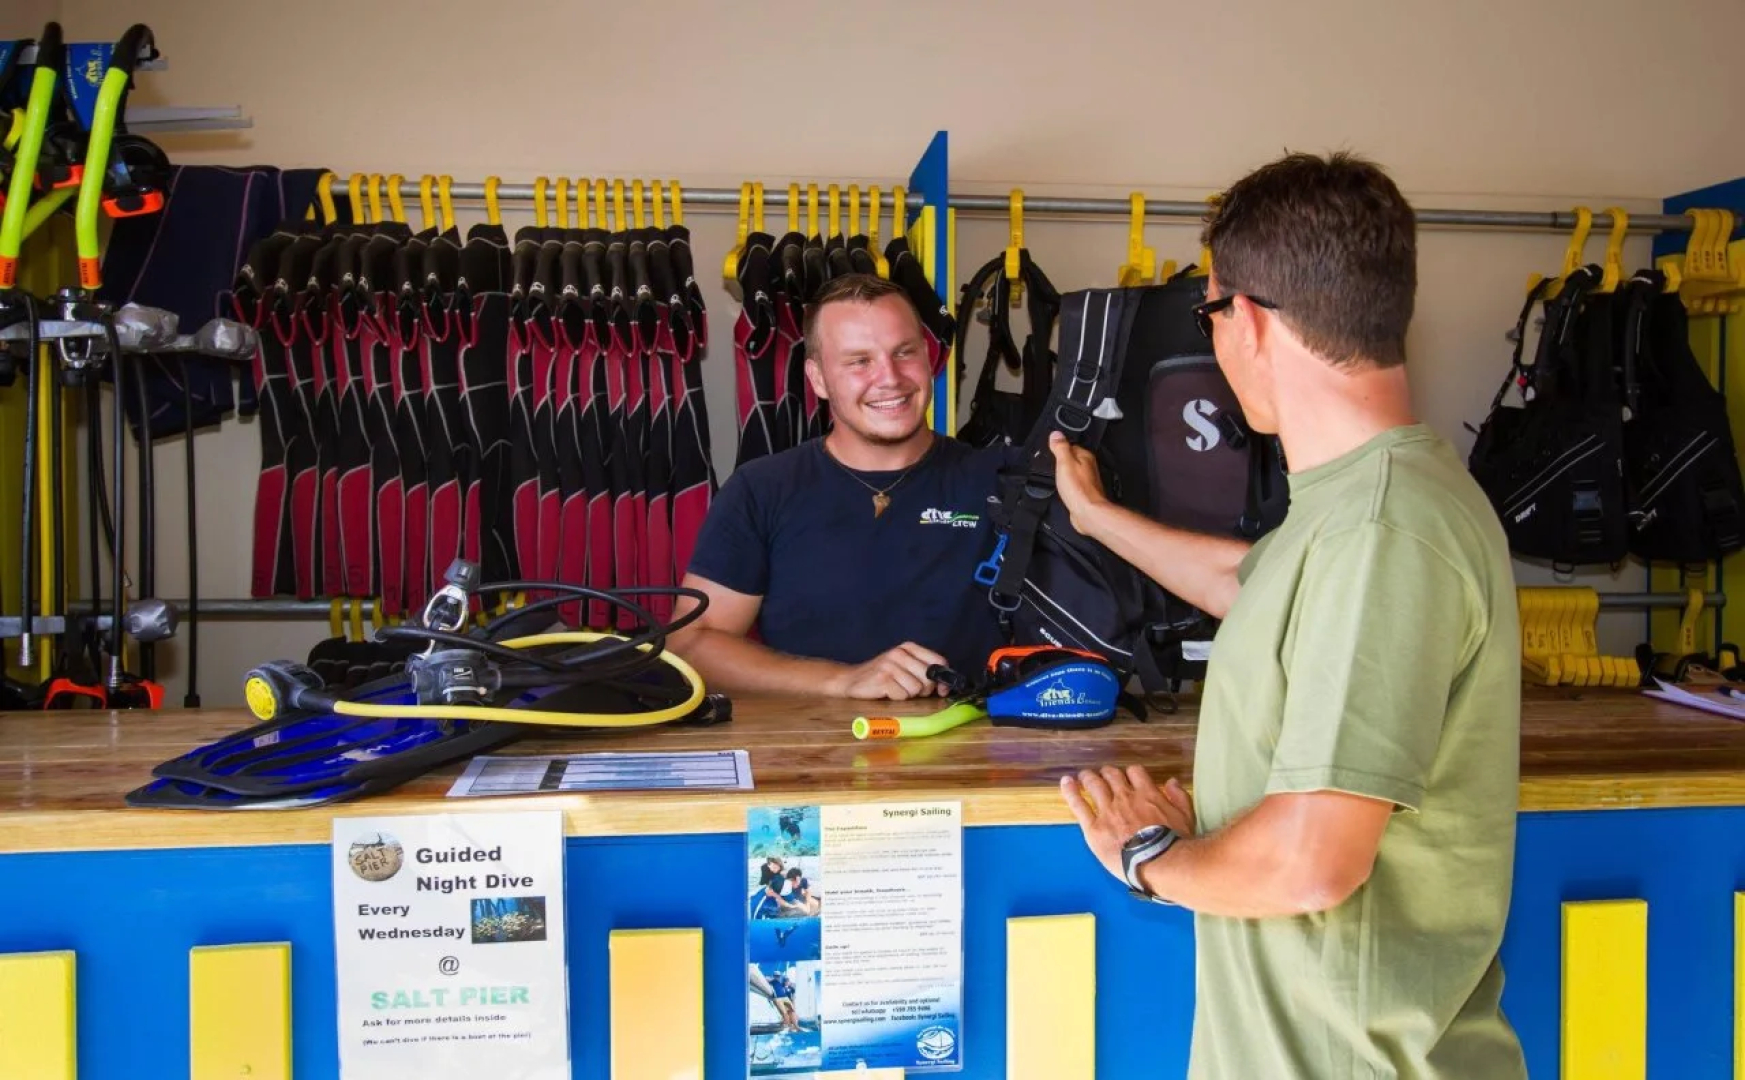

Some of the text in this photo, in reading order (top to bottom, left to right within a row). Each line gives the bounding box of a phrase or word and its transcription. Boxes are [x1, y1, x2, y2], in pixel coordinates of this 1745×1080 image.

[883, 807, 952, 818] Synergi Sailing
[355, 848, 386, 866] SALT
[416, 846, 502, 864] Guided
[360, 857, 389, 875] PIER
[416, 874, 534, 894] Night Dive
[358, 904, 410, 918] Every
[358, 927, 466, 940] Wednesday
[438, 956, 460, 976] @
[371, 986, 531, 1010] SALT PIER
[362, 1014, 507, 1028] Ask for more details inside
